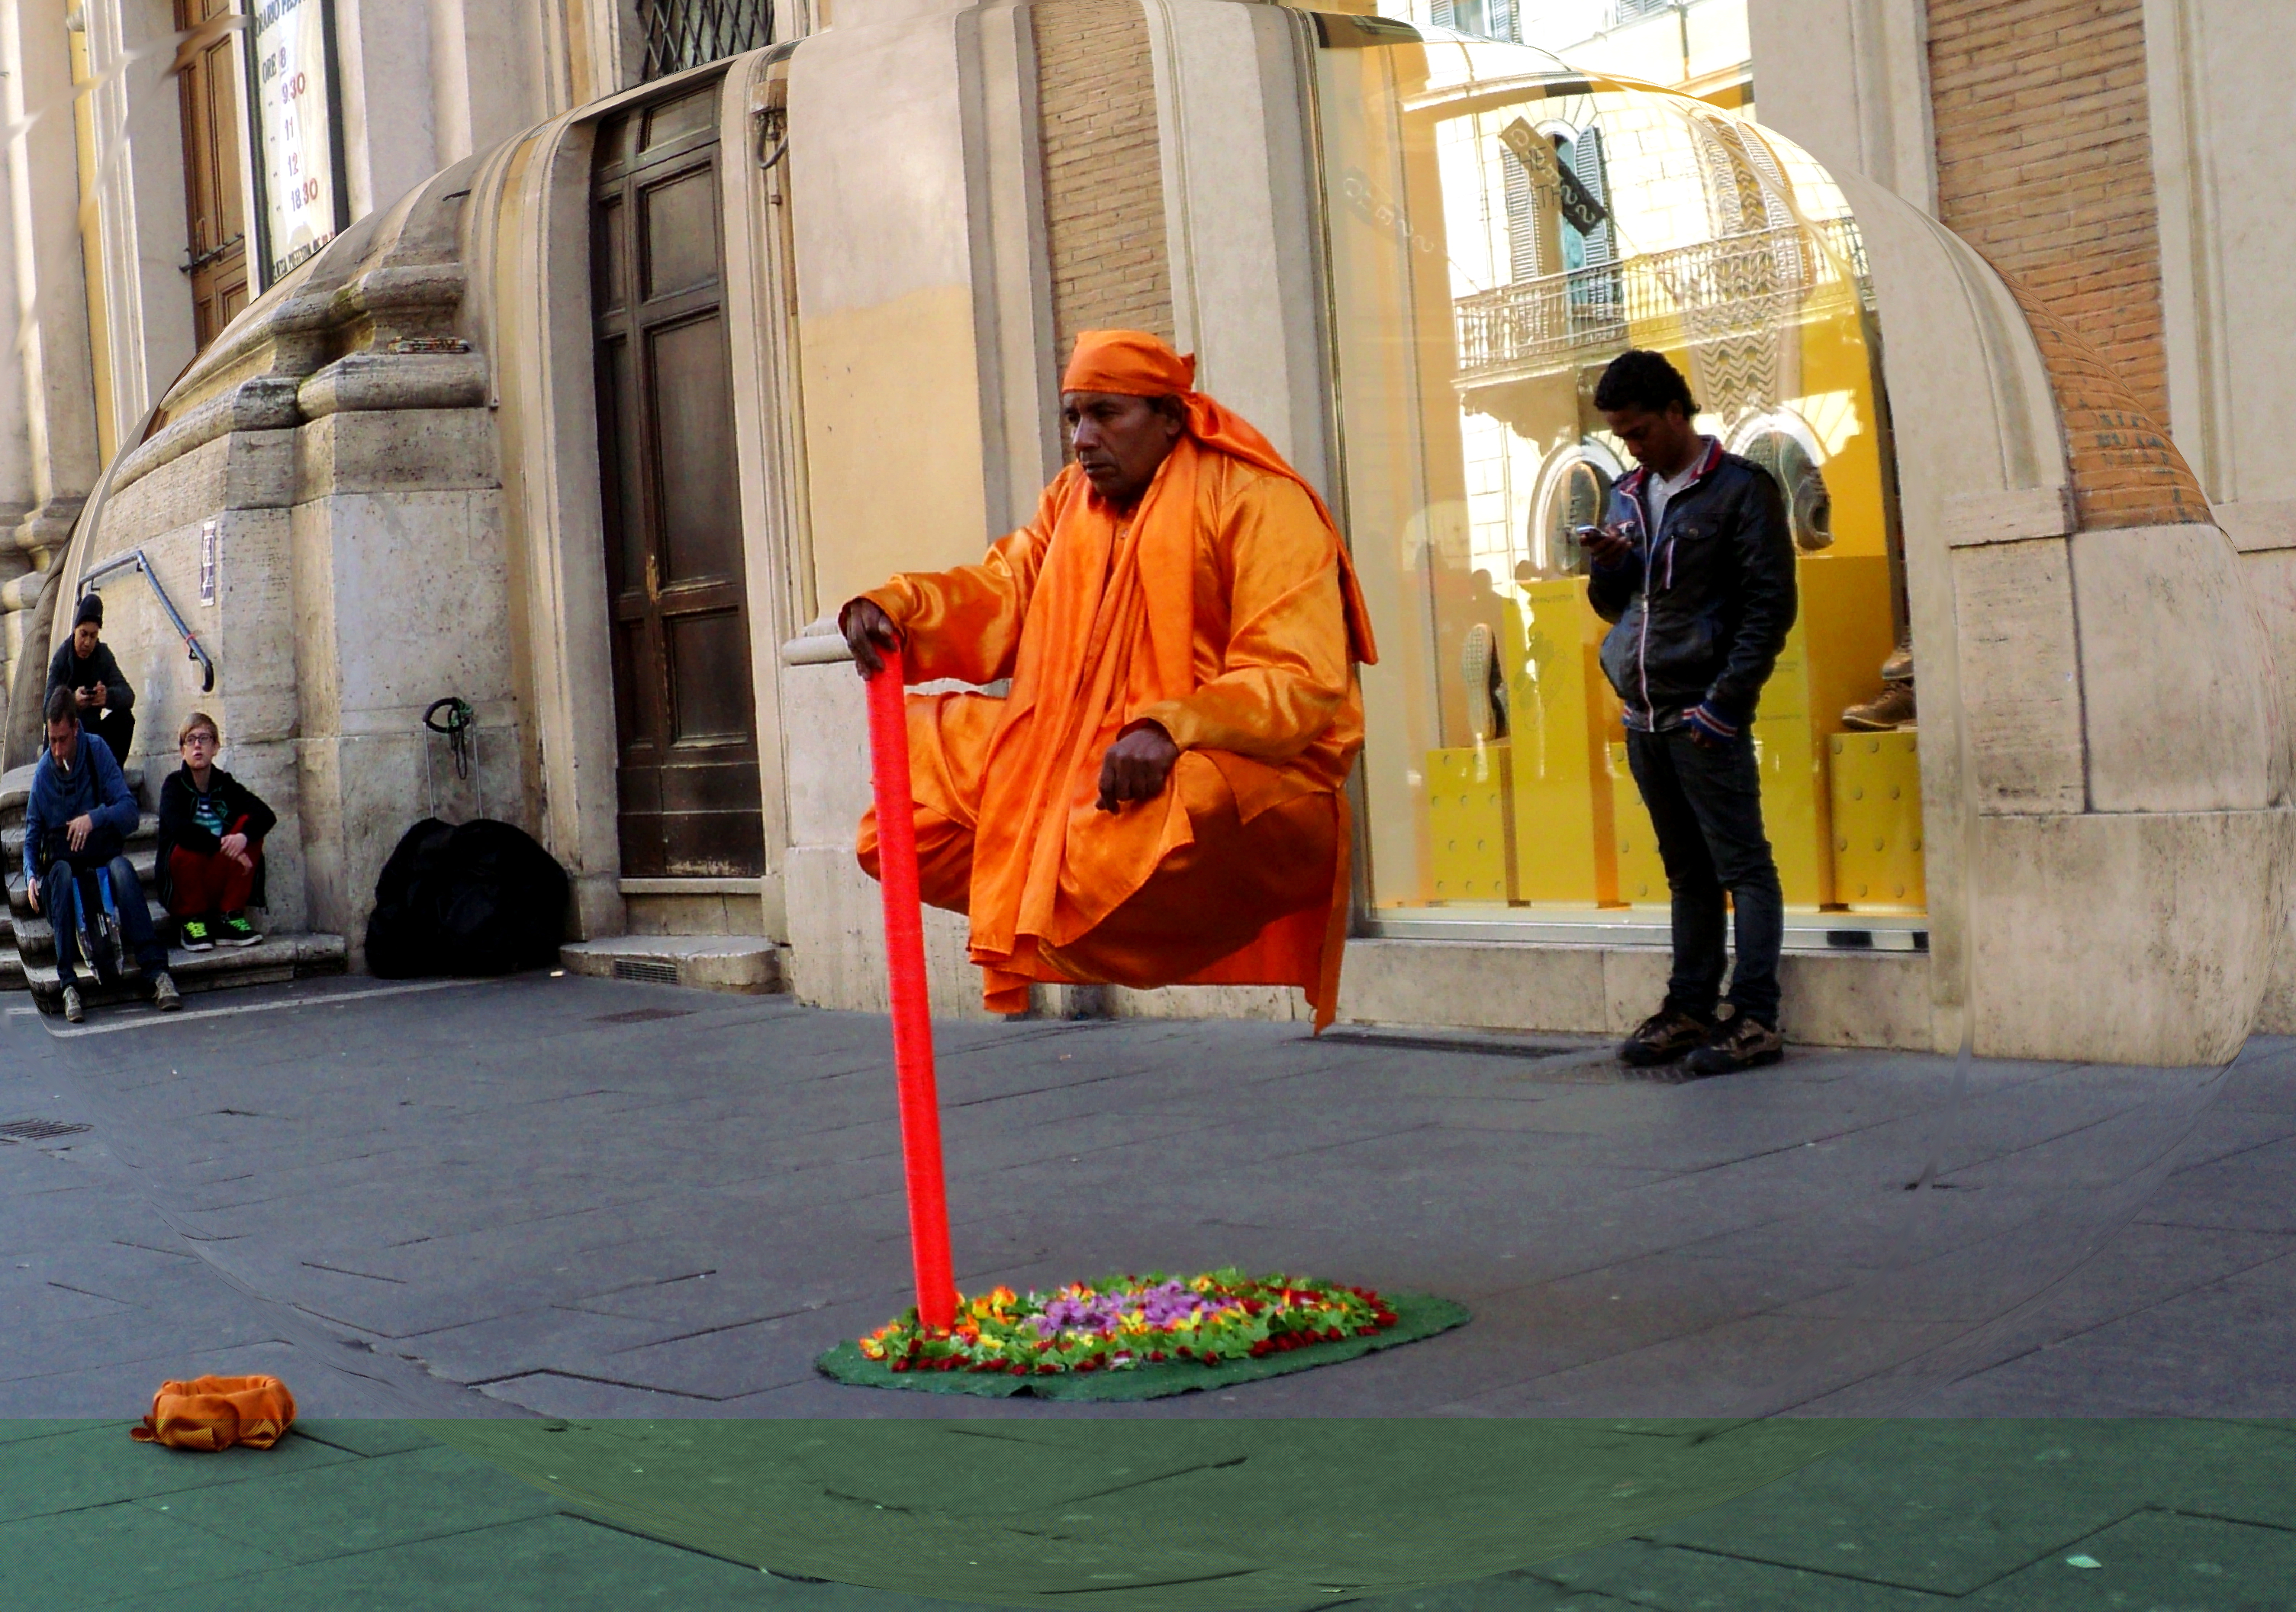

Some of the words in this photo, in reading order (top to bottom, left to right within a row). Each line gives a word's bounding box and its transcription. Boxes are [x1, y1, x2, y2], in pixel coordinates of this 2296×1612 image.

[262, 53, 277, 84] ORE
[280, 47, 287, 69] 8
[282, 72, 306, 105] 9.30
[285, 116, 294, 141] 11
[288, 152, 299, 177] 12
[291, 178, 318, 212] 18.30
